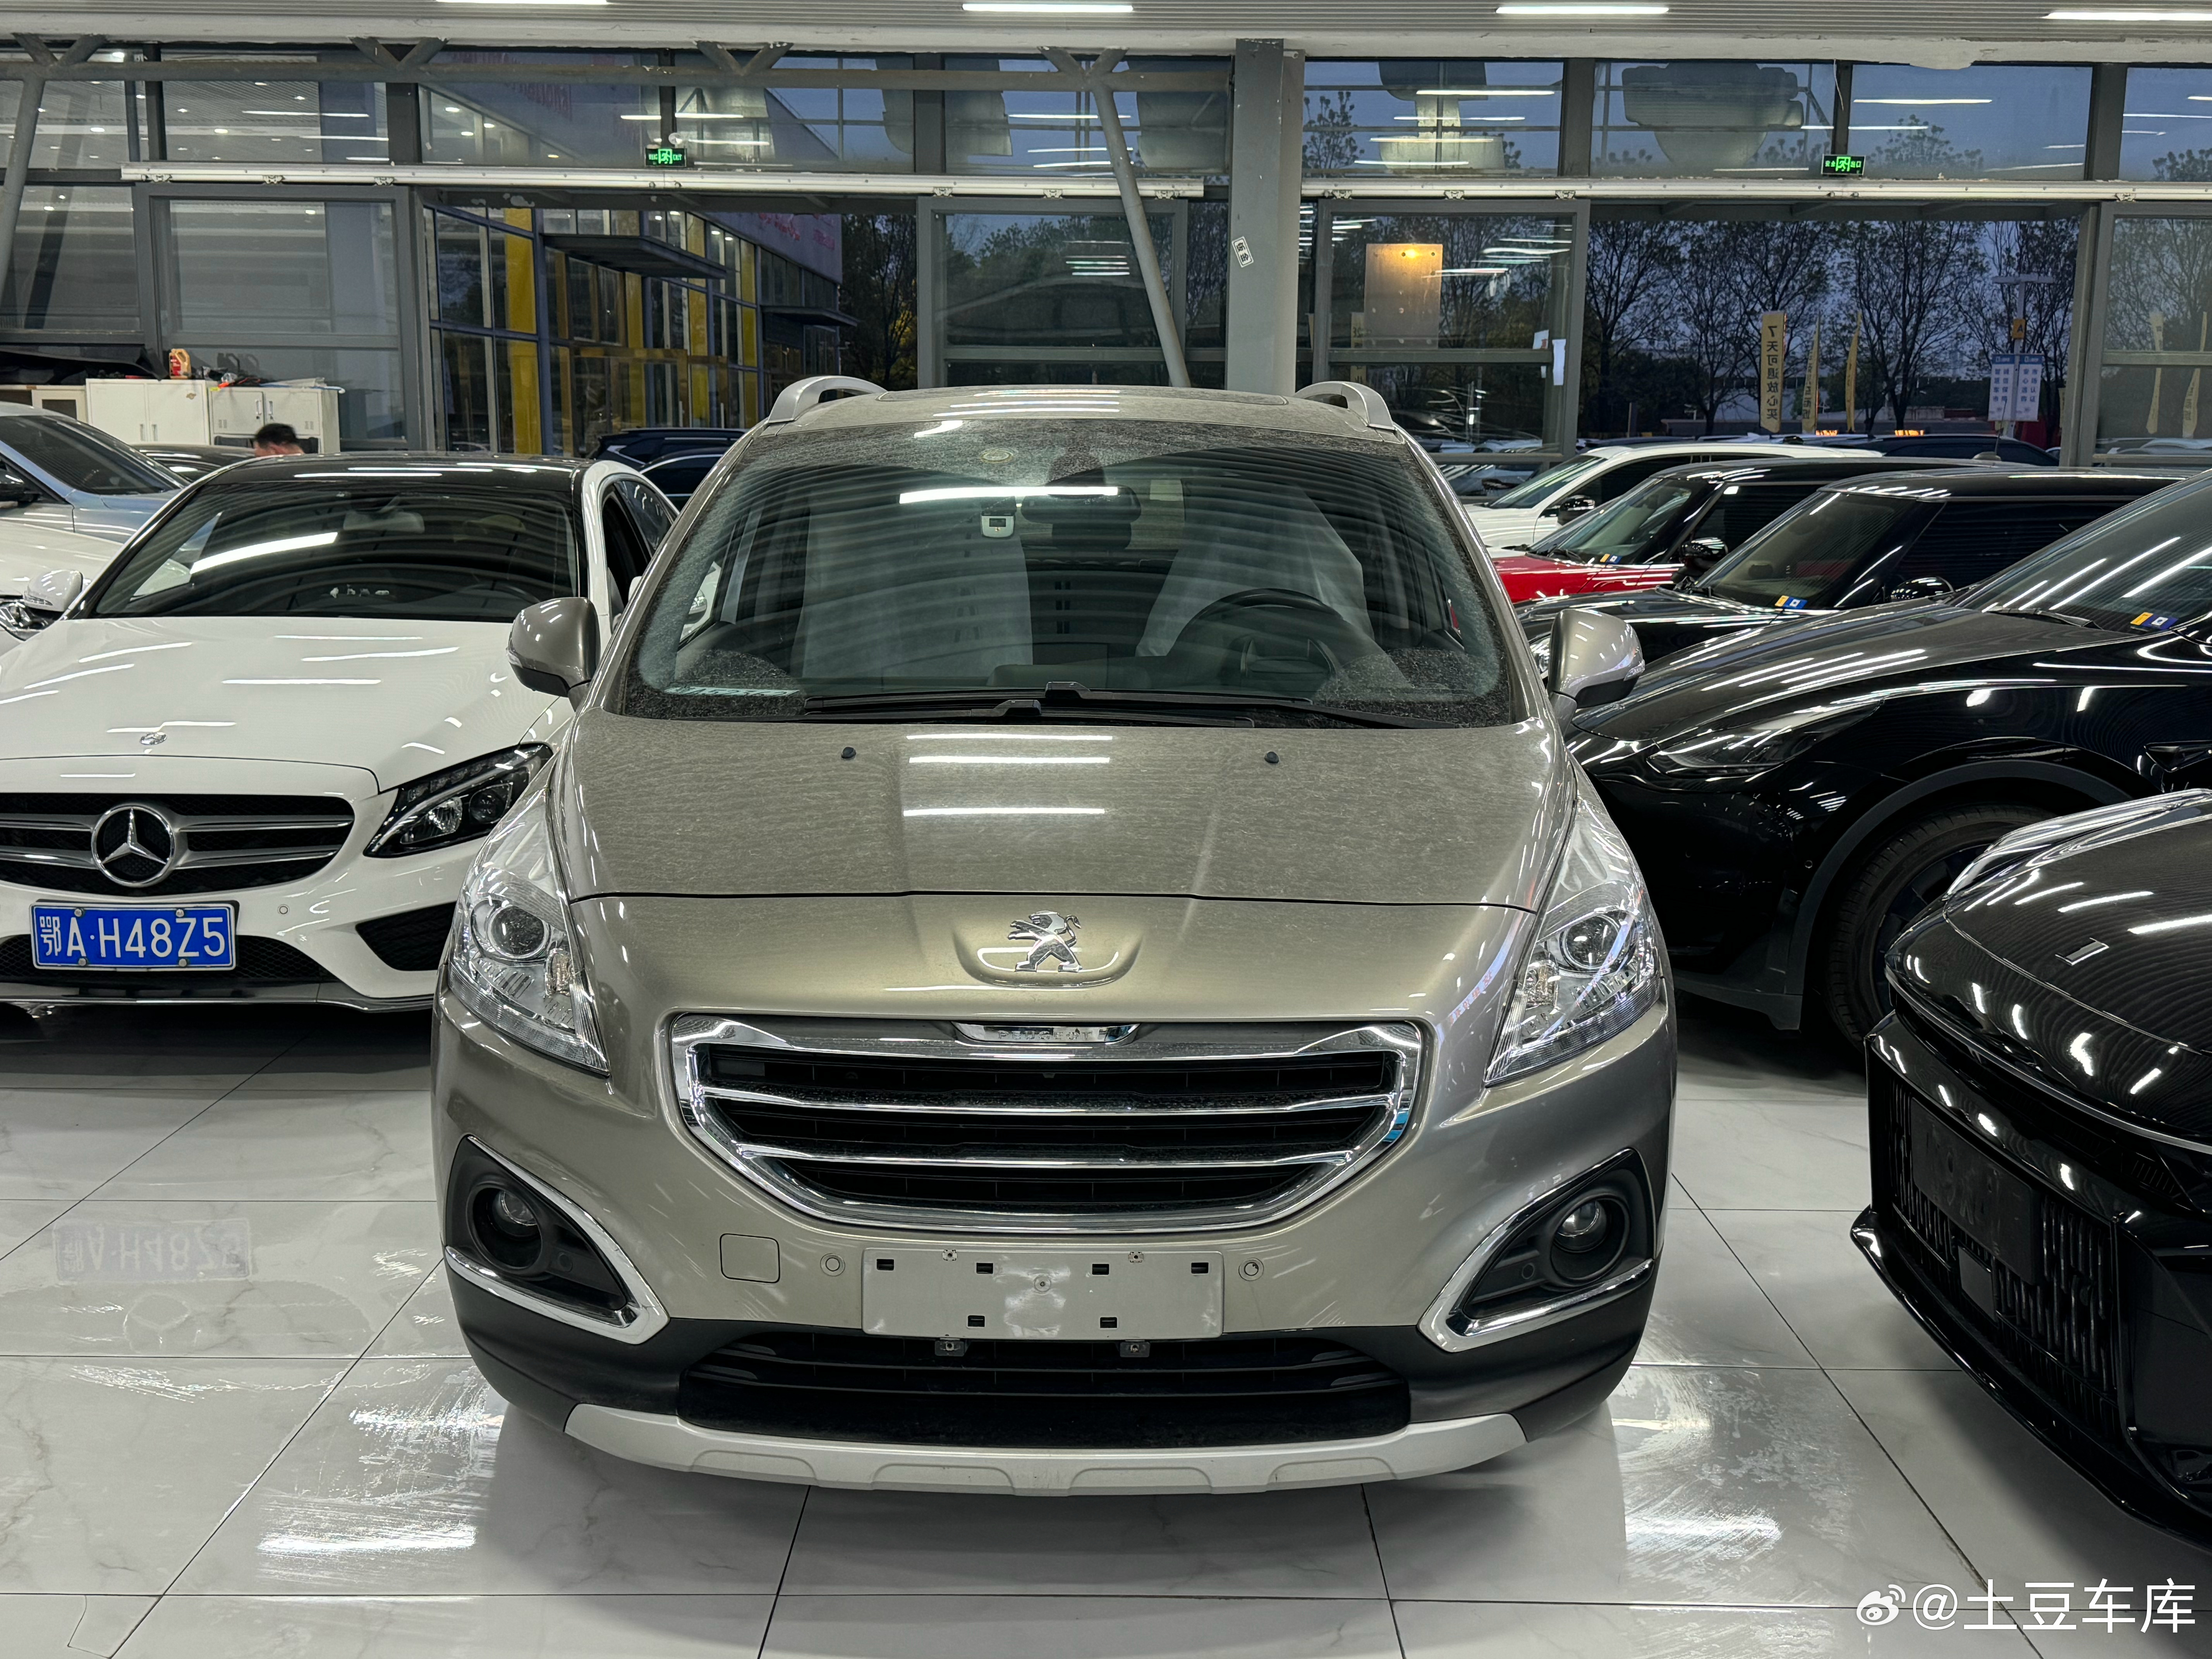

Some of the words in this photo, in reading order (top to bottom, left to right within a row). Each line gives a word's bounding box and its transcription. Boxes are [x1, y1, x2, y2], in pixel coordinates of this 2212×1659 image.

[1237, 242, 1249, 262] 钣金
[39, 915, 225, 958] 鄂A·H48Z5
[998, 1030, 1093, 1040] PEUGEOT
